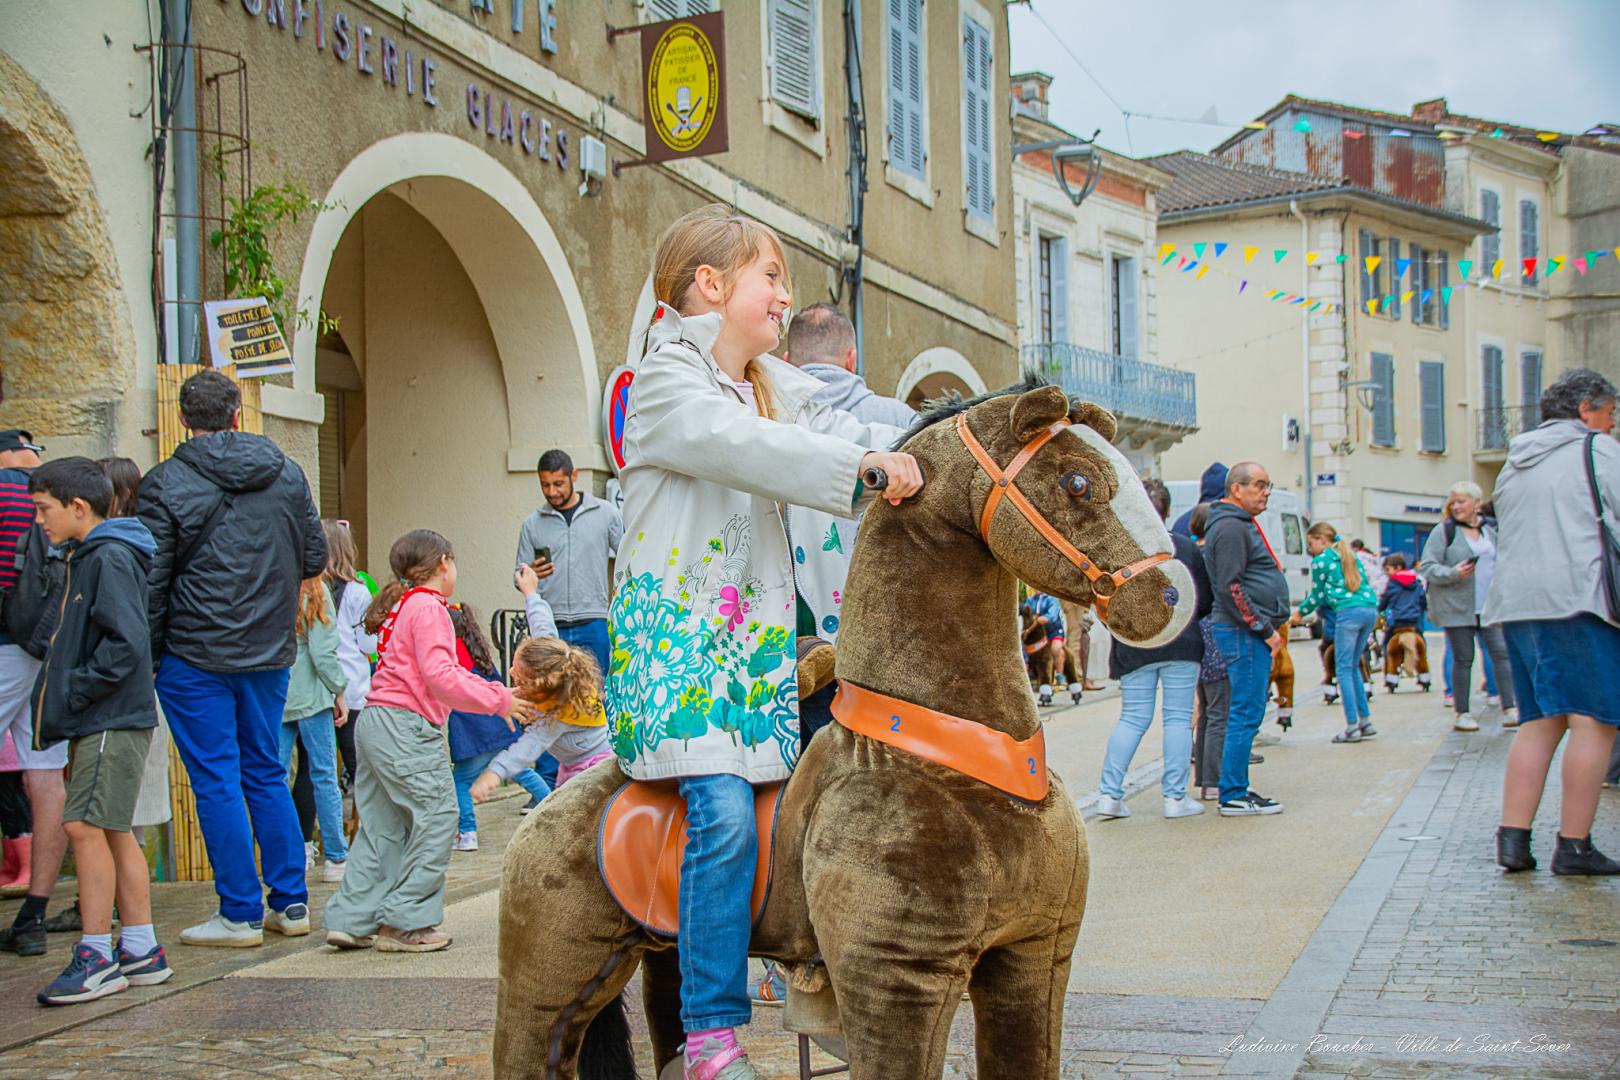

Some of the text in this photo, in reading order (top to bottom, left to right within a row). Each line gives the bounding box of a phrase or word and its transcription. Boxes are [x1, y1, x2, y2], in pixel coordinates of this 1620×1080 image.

[667, 45, 698, 55] ARTISAN
[669, 74, 696, 85] FRANCE
[466, 83, 570, 170] GLACES
[223, 308, 259, 326] TOILETTES
[235, 344, 256, 359] POSTE
[890, 715, 901, 732] 2
[1027, 757, 1036, 774] 2
